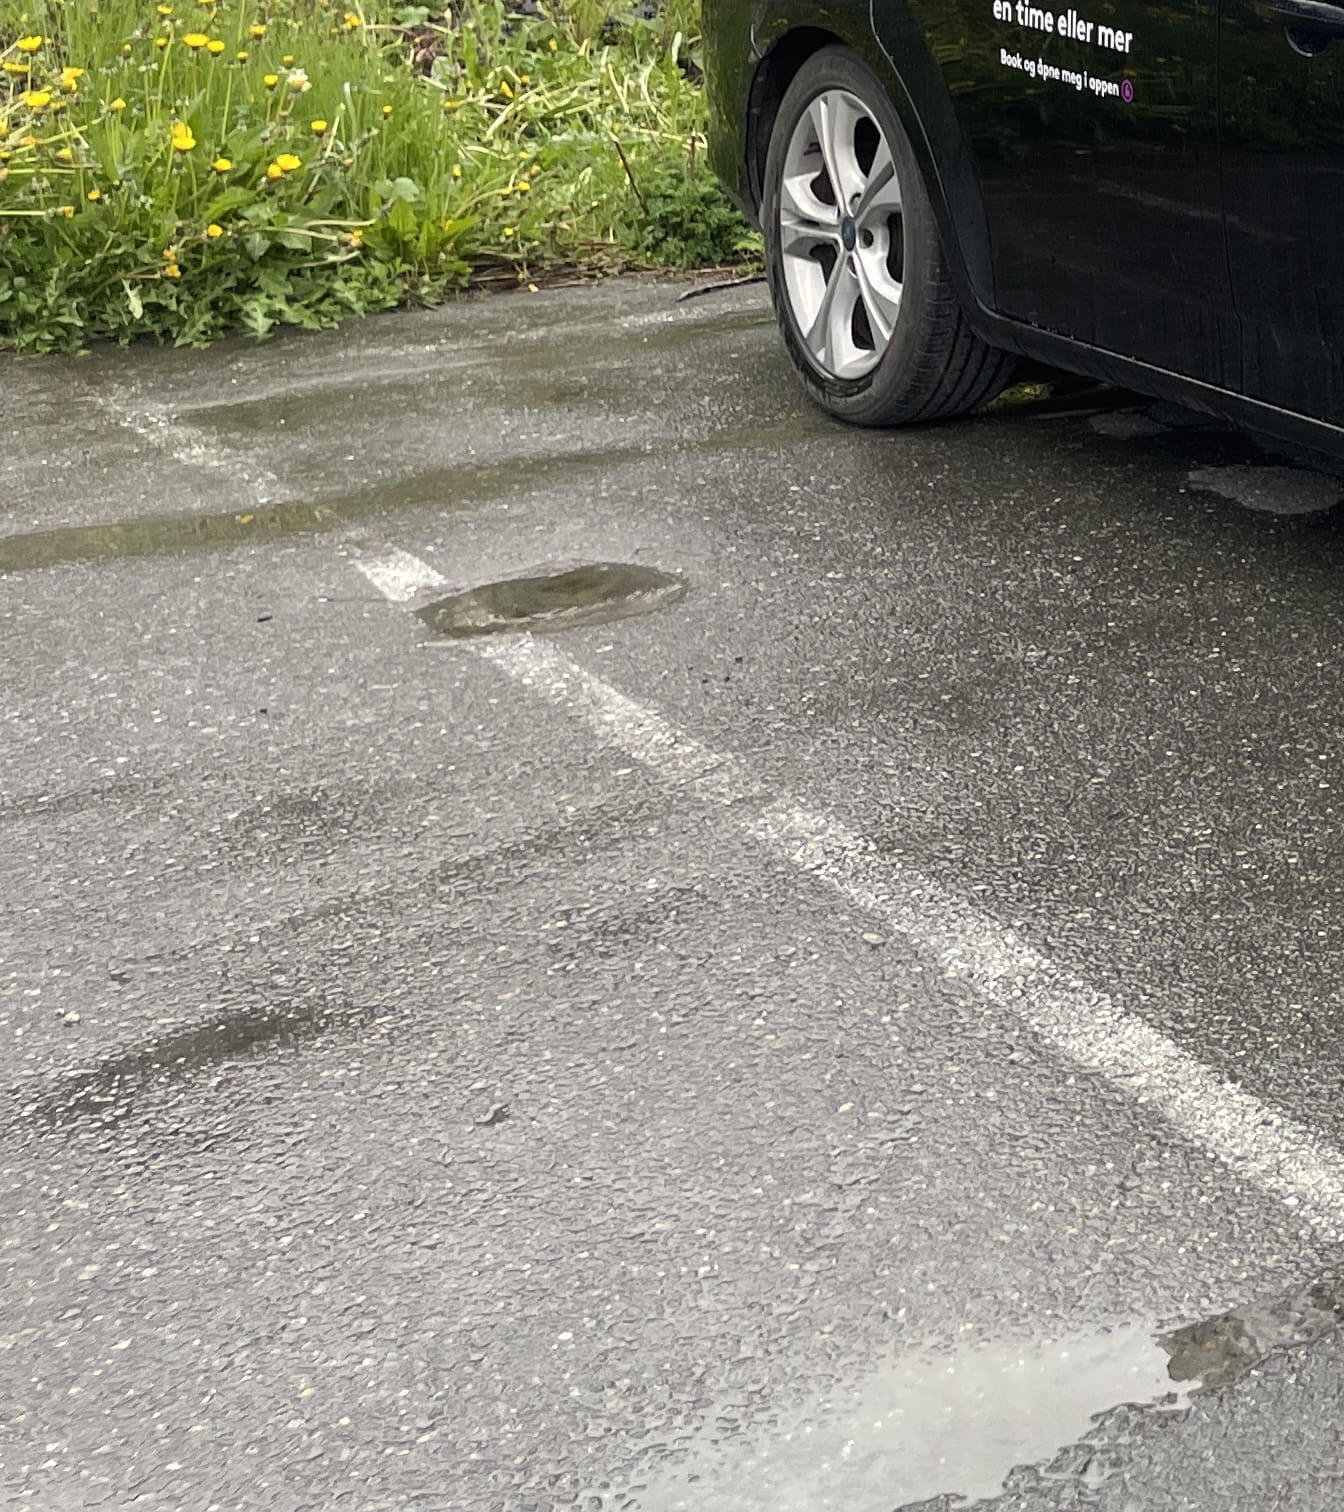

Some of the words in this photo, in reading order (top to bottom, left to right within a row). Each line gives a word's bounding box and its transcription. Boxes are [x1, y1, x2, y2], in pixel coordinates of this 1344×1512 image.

[993, 0, 1012, 23] en
[1057, 9, 1094, 43] eller
[1098, 24, 1133, 53] mer
[1000, 48, 1023, 70] Book
[1024, 60, 1036, 77] og
[1037, 58, 1060, 81] åpne
[1061, 69, 1082, 91] meg
[1089, 76, 1120, 98] appen
